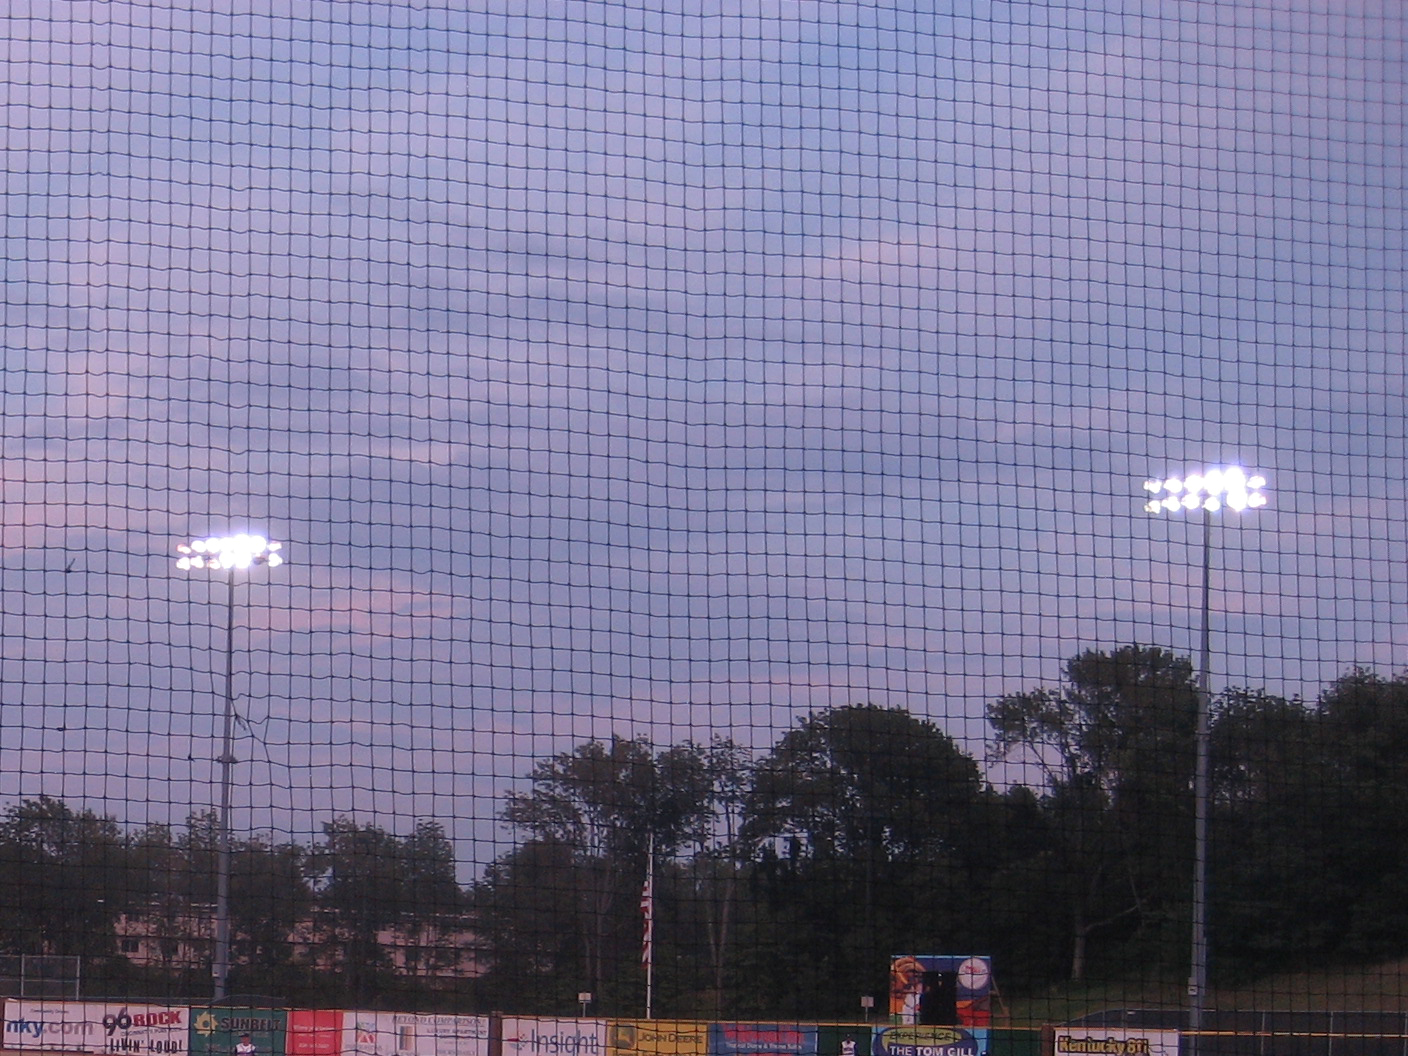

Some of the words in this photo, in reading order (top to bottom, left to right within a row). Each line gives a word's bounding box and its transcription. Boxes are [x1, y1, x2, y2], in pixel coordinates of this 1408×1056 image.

[6, 1017, 93, 1038] nky.com
[102, 1007, 132, 1036] 96
[133, 1011, 181, 1026] ROCK
[110, 1038, 144, 1052] LIVIN'
[150, 1039, 182, 1053] LOUD!
[639, 1032, 666, 1042] JOHN
[668, 1033, 703, 1043] DEERE
[1058, 1035, 1125, 1056] Kentucky
[890, 1046, 912, 1056] THE
[916, 1047, 943, 1056] TOM
[947, 1047, 974, 1056] GILL
